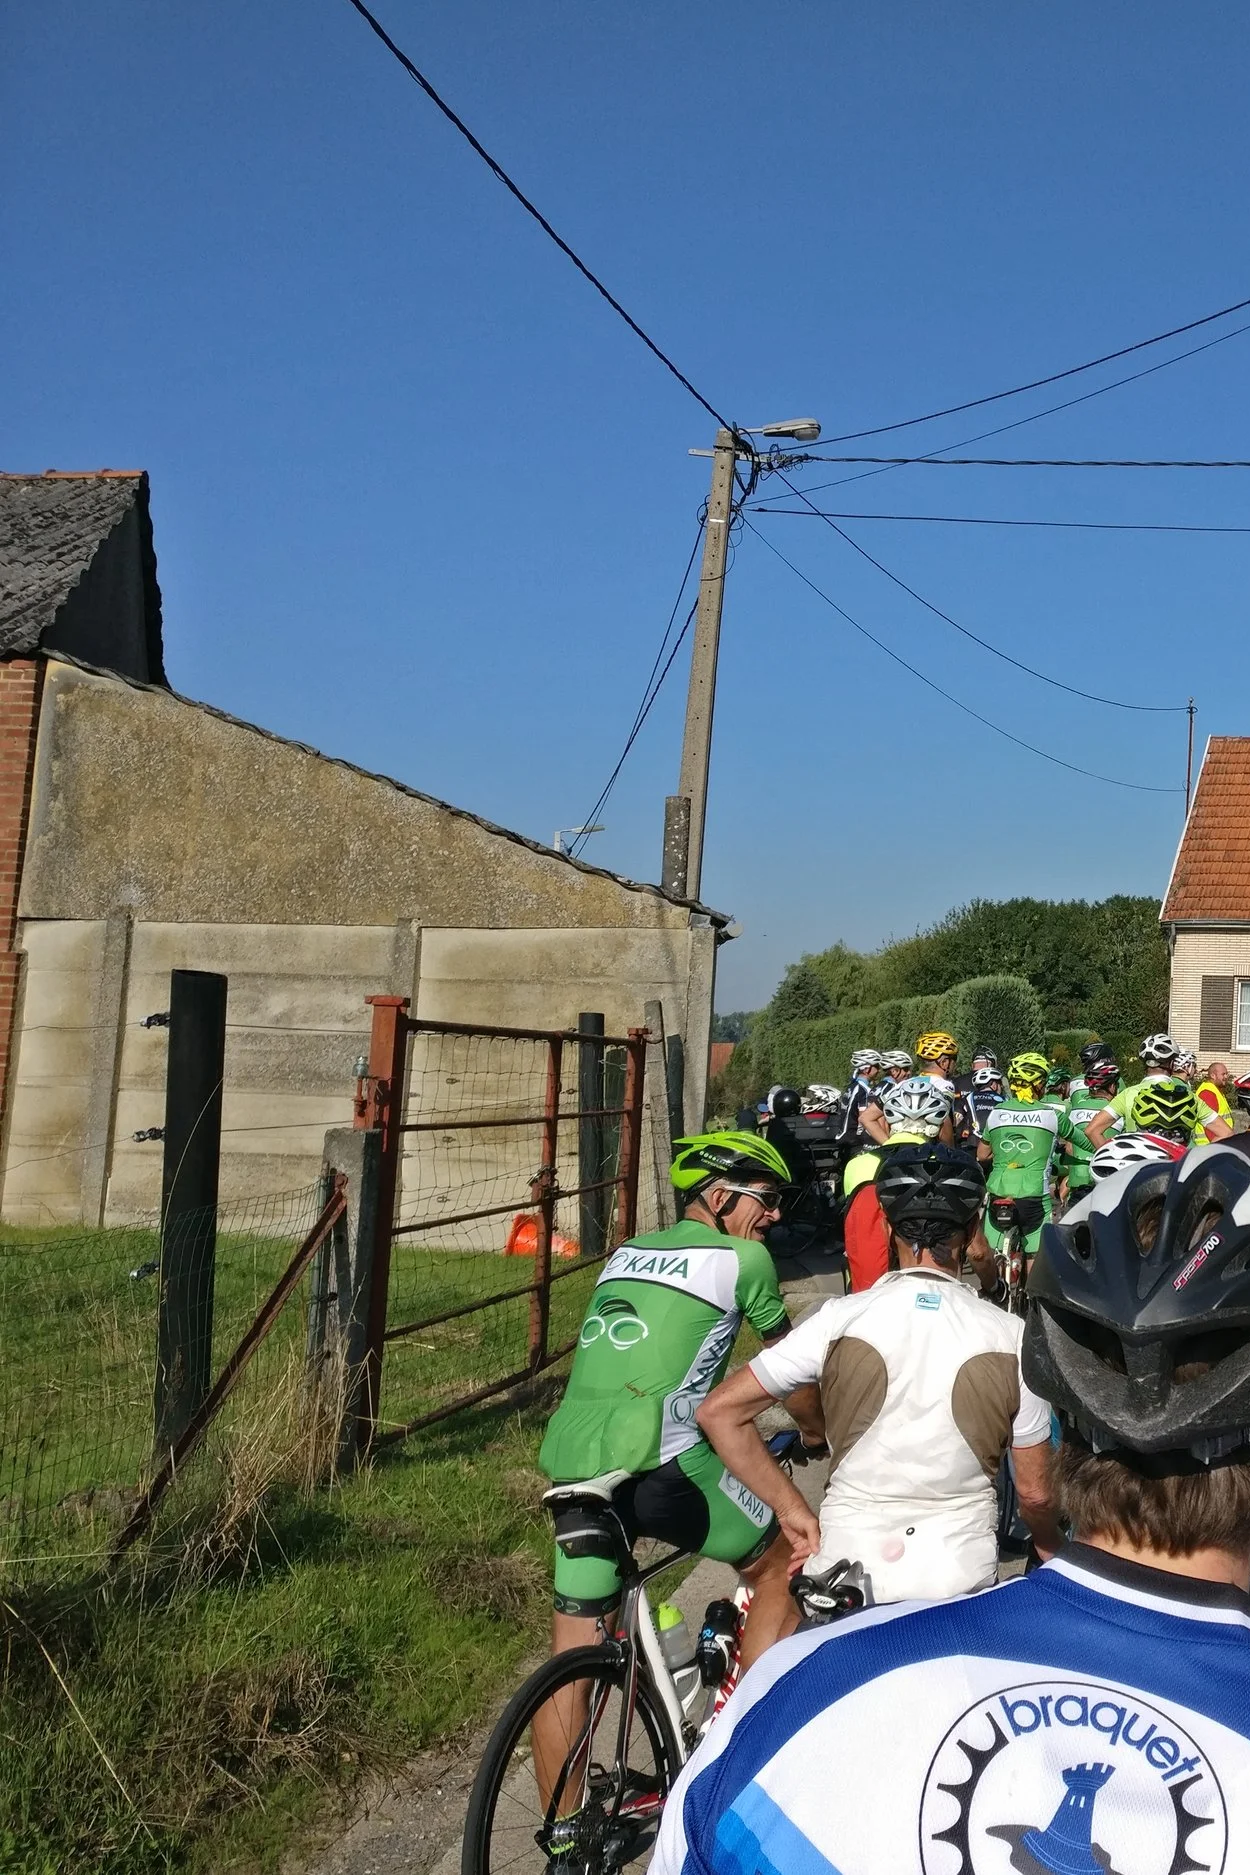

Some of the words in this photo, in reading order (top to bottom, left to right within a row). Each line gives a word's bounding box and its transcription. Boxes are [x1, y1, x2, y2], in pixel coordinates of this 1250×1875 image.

[1012, 1113, 1042, 1124] KAVA
[1202, 1235, 1220, 1255] 700
[622, 1255, 690, 1279] KAVA
[738, 1485, 764, 1523] KAVA
[998, 1693, 1202, 1782] braquet
